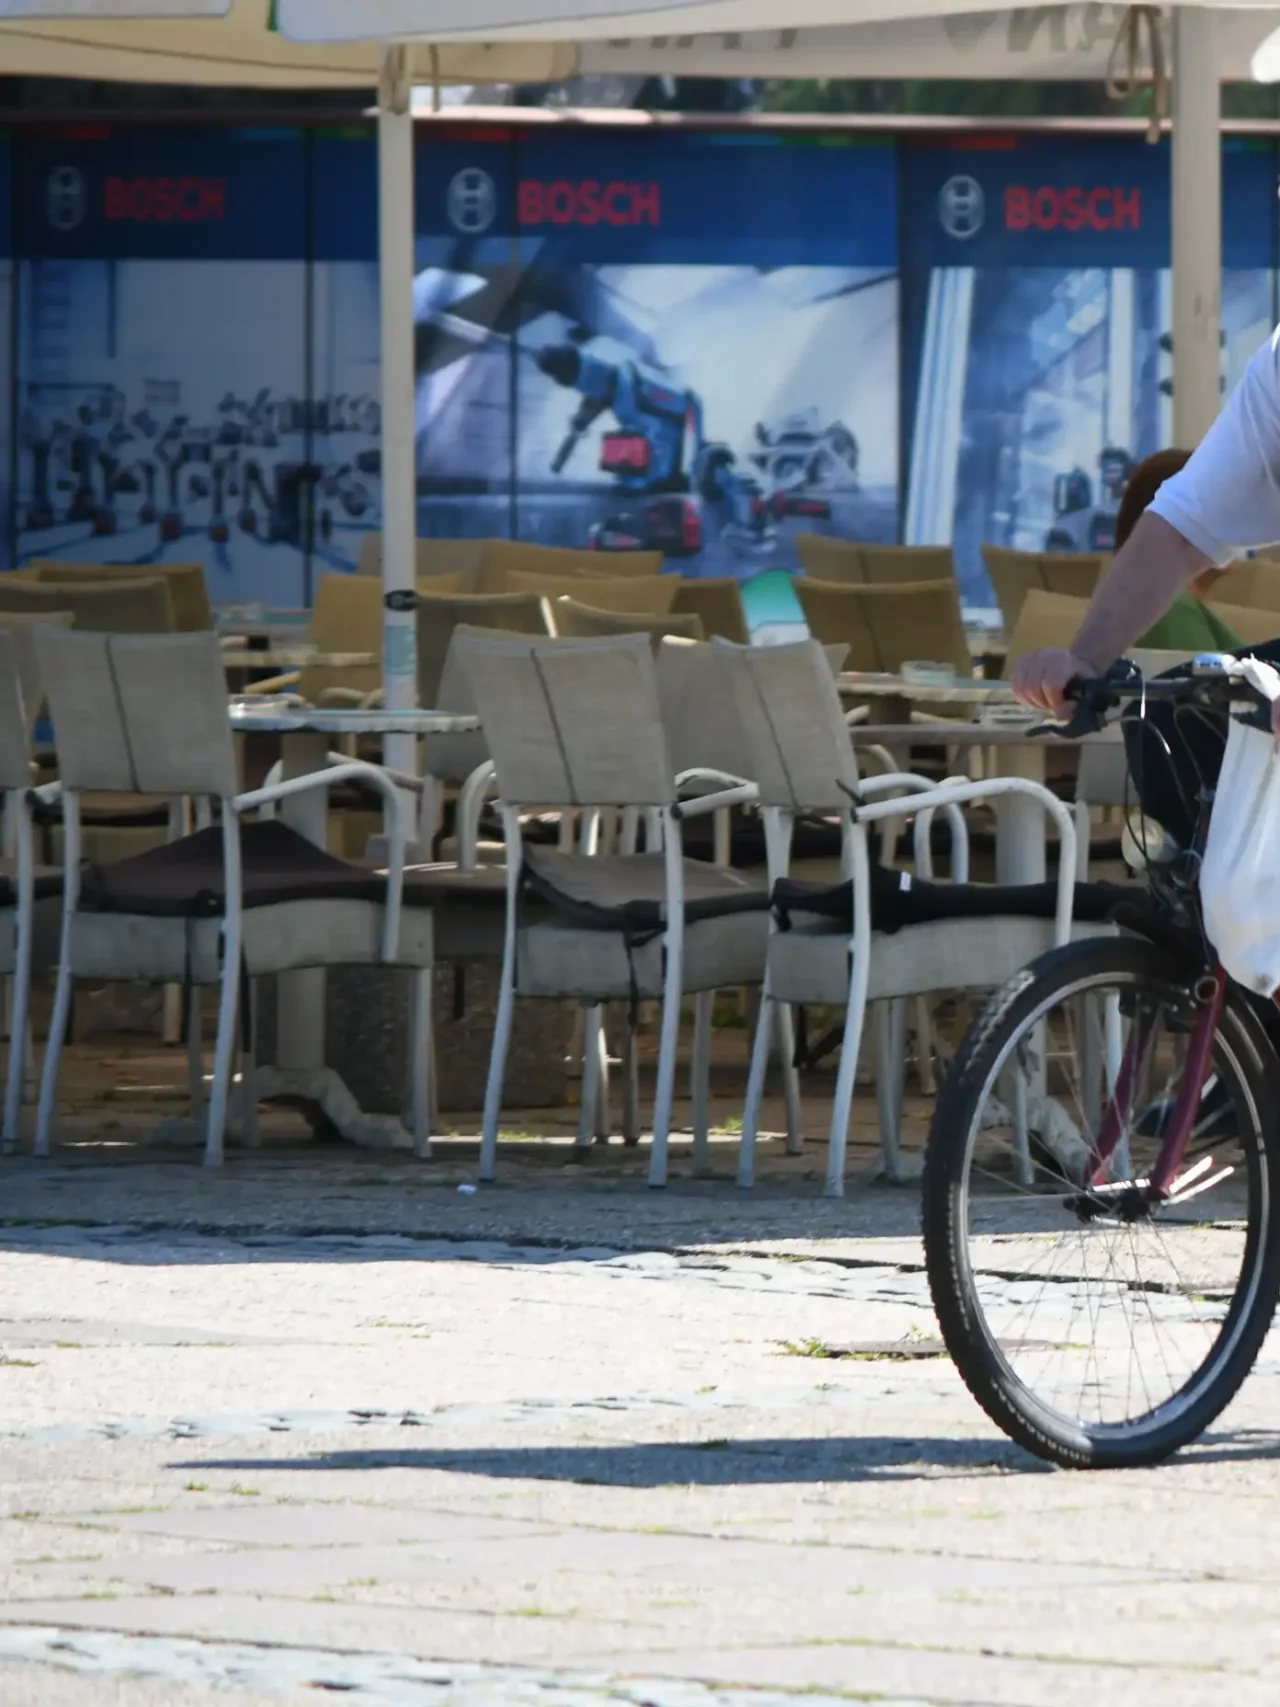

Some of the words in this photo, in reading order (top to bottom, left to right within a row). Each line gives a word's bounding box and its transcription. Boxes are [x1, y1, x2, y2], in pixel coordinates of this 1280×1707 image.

[105, 177, 225, 220] BOSCH
[517, 179, 661, 226] BOSCH
[1005, 185, 1141, 231] BOSCH
